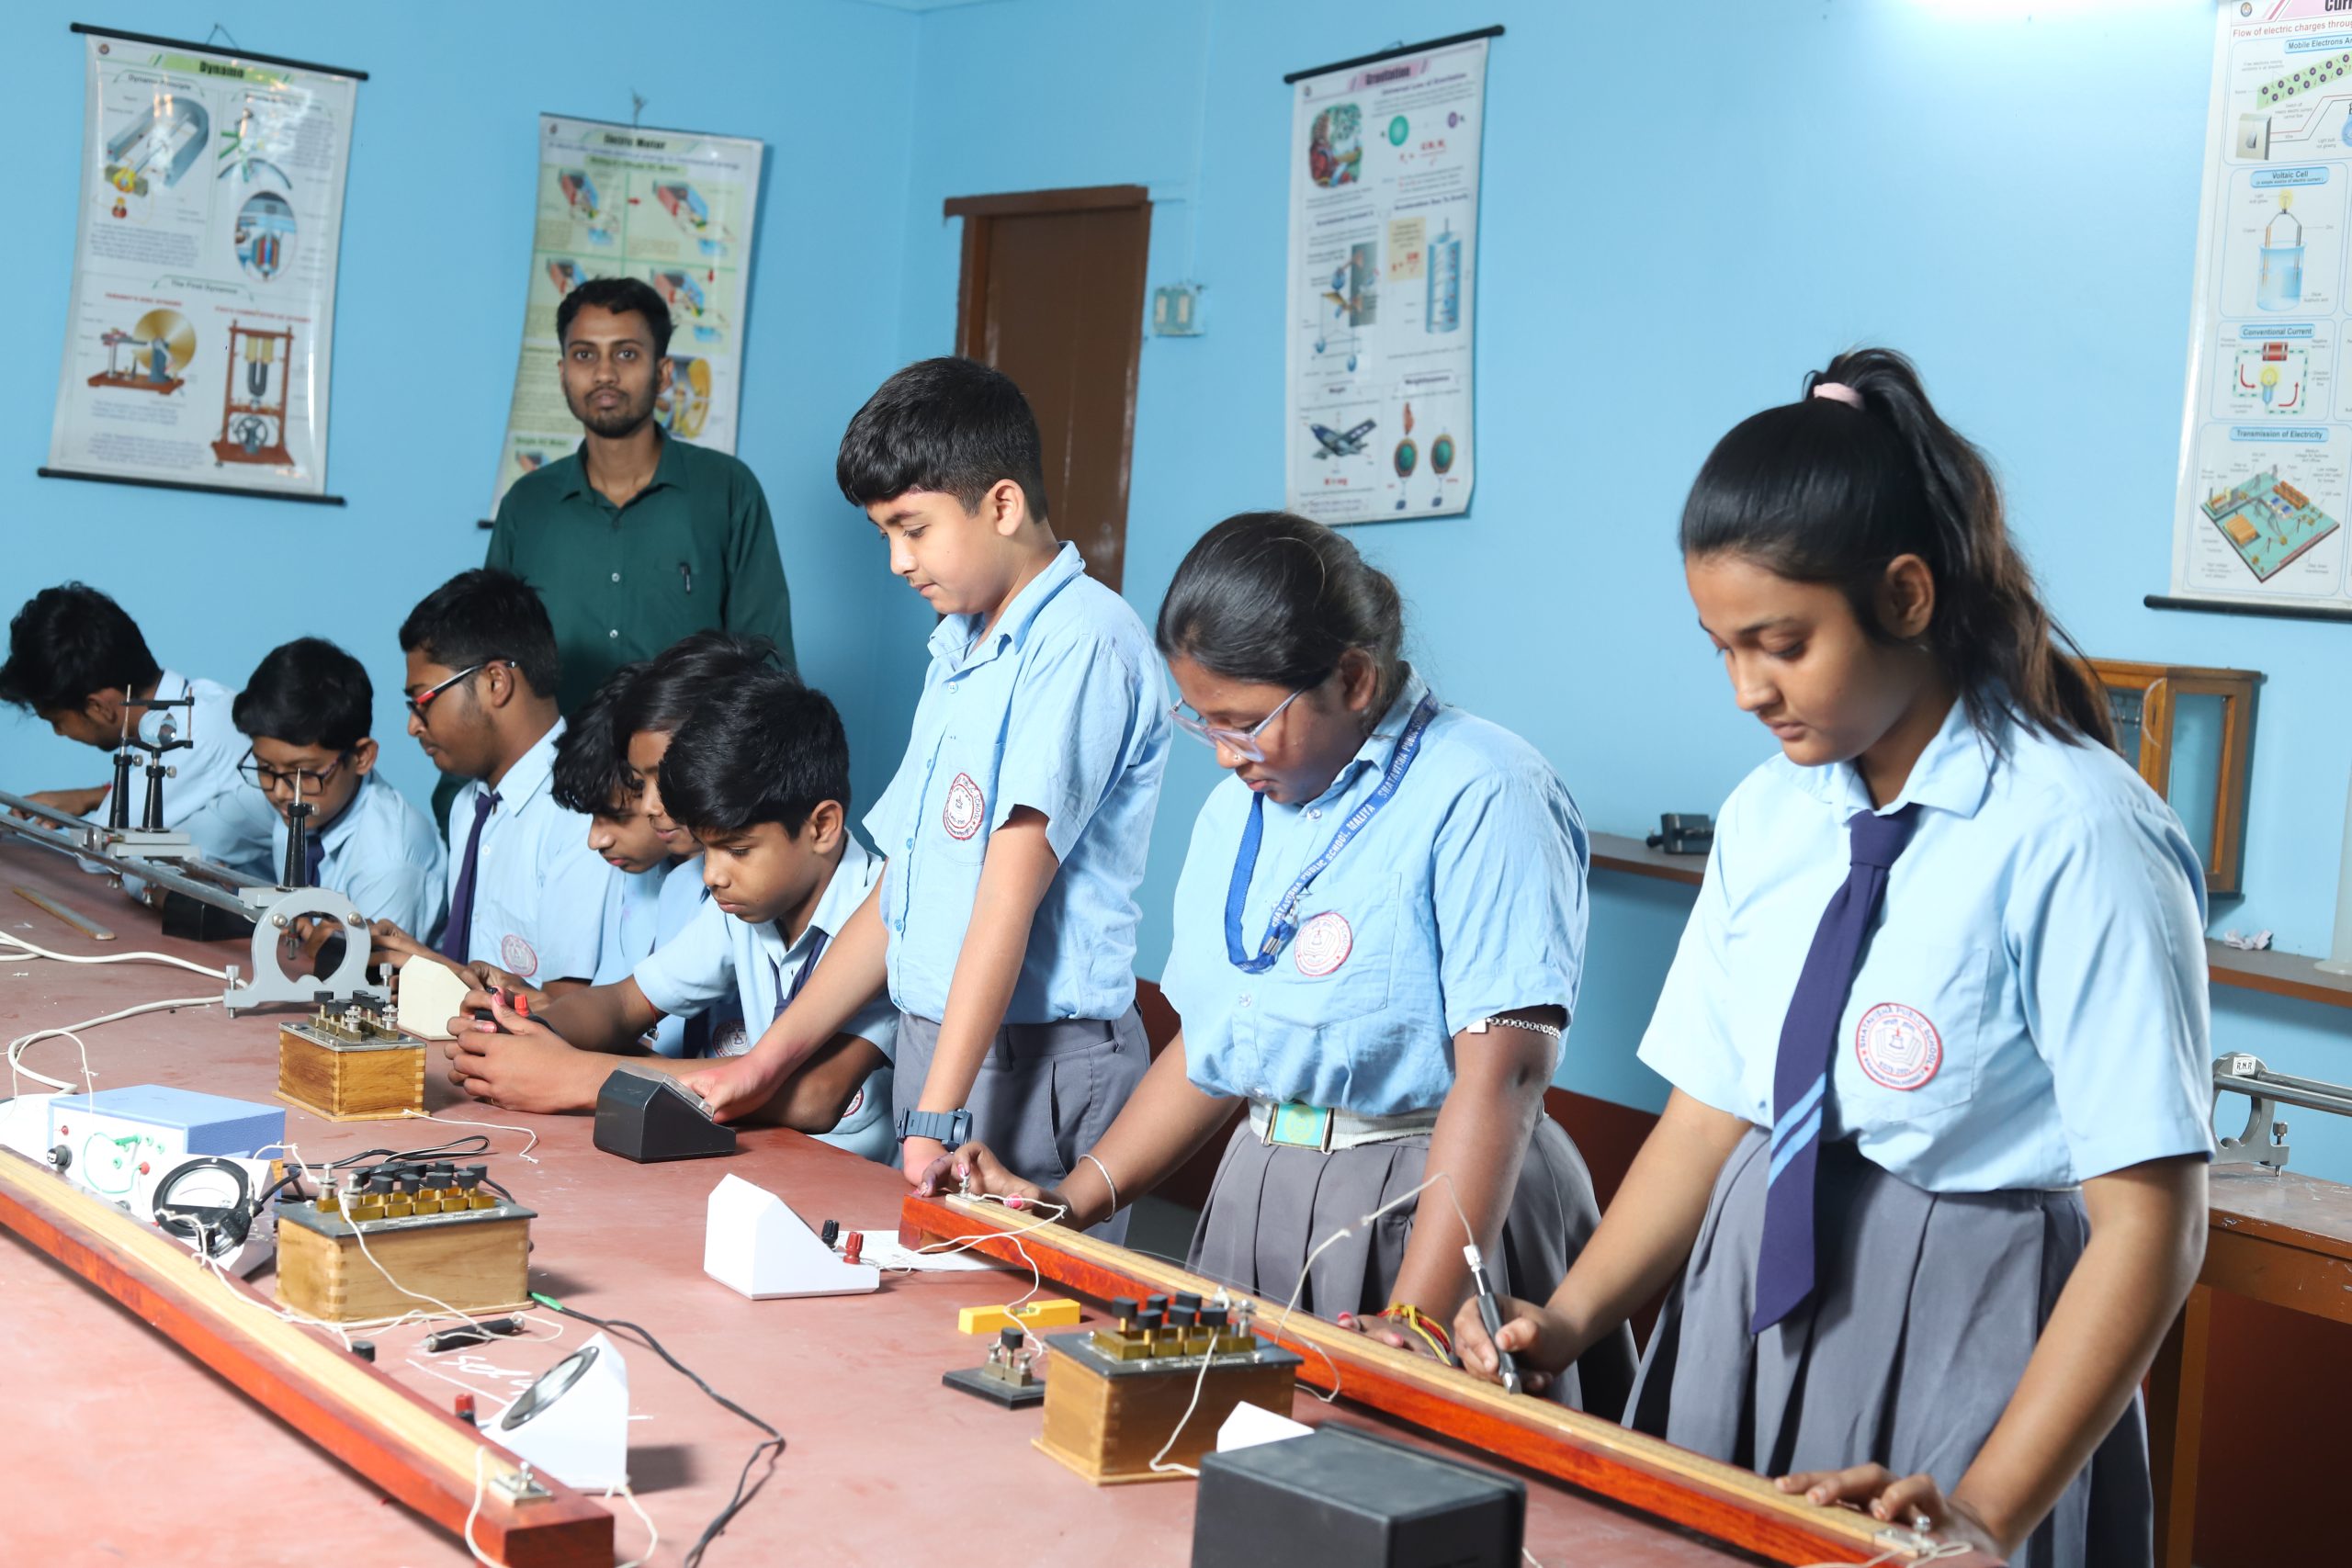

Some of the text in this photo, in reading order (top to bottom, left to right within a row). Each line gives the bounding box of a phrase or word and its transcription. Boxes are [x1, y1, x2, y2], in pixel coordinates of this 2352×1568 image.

[2233, 28, 2251, 37] Flow
[2264, 26, 2291, 35] electric
[2295, 22, 2325, 32] charges
[2312, 39, 2343, 48] Electrons
[199, 61, 244, 79] Dynamo
[2272, 170, 2309, 179] Voltaic Cell
[2243, 328, 2286, 336] Conventional
[2237, 430, 2323, 439] Transmission of Electricity
[1378, 752, 1408, 798] SHATAVISHA
[1301, 860, 1327, 881] PUBLIC
[1346, 804, 1375, 830] MALIYA
